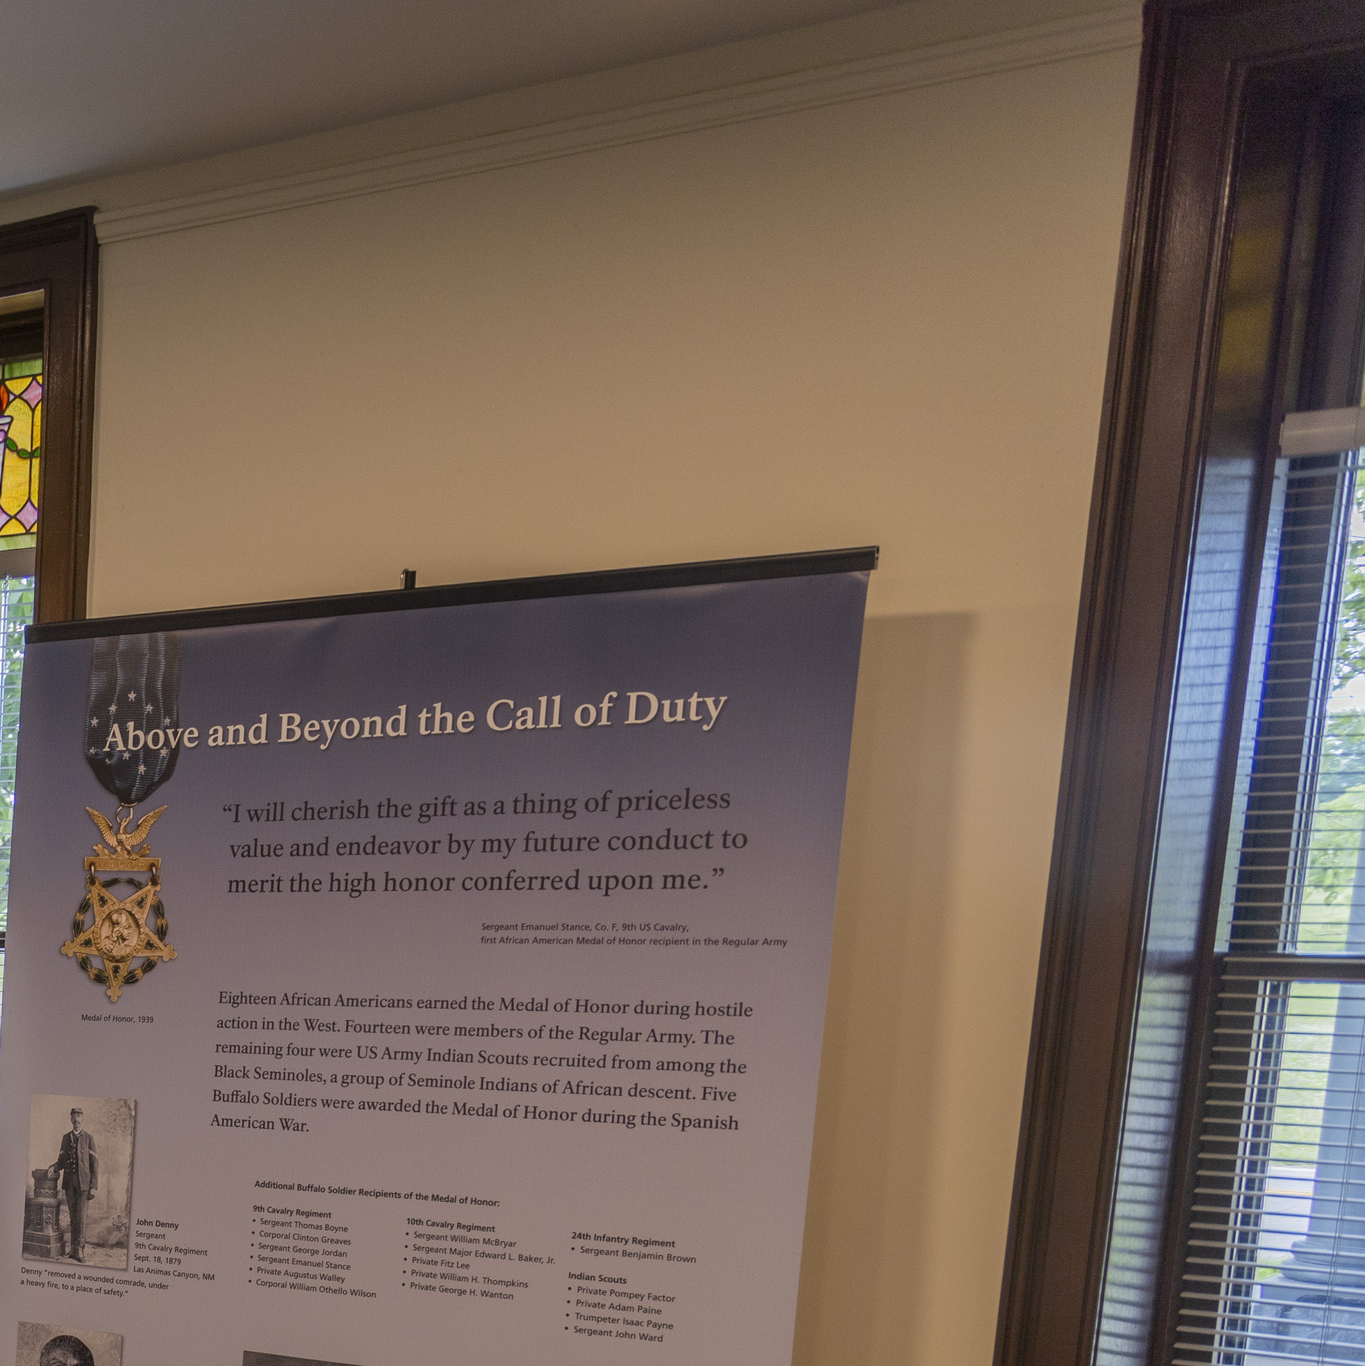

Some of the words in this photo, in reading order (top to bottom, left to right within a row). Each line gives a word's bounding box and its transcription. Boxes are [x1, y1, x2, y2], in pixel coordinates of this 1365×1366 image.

[103, 722, 198, 752] Above
[208, 713, 267, 746] and
[278, 704, 407, 750] Beyond
[418, 702, 474, 735] the
[487, 695, 561, 730] Call
[575, 691, 617, 726] of
[625, 692, 727, 730] Duty
[223, 804, 241, 823] “I
[247, 802, 284, 822] will
[291, 799, 369, 821] cherish
[377, 798, 412, 818] the
[418, 795, 457, 824] gift
[463, 800, 487, 817] as
[492, 799, 506, 816] a
[513, 793, 577, 820] thing
[585, 790, 612, 812] of
[615, 788, 730, 818] priceless
[230, 838, 283, 858] value
[290, 836, 329, 857] and
[336, 835, 441, 856] endeavor
[448, 833, 475, 860] by
[481, 838, 517, 859] my
[523, 831, 599, 852] future
[608, 828, 714, 851] conduct
[722, 830, 747, 849] to
[227, 874, 283, 893] merit
[289, 872, 322, 892] the
[329, 872, 376, 898] high
[383, 871, 455, 892] honor
[462, 869, 579, 891] conferred
[588, 875, 653, 896] upon
[661, 868, 724, 889] me.”
[80, 1013, 103, 1022] Medal
[102, 1014, 112, 1023] of
[137, 1015, 155, 1024] 1939
[219, 991, 276, 1008] Eighteen
[279, 991, 332, 1007] African
[333, 993, 414, 1009] Americans
[416, 995, 468, 1011] earned
[471, 995, 495, 1011] the
[498, 997, 550, 1013] Medal
[552, 997, 573, 1013] of
[574, 998, 630, 1015] Honor
[634, 1000, 690, 1020] during
[695, 1001, 753, 1017] hostile
